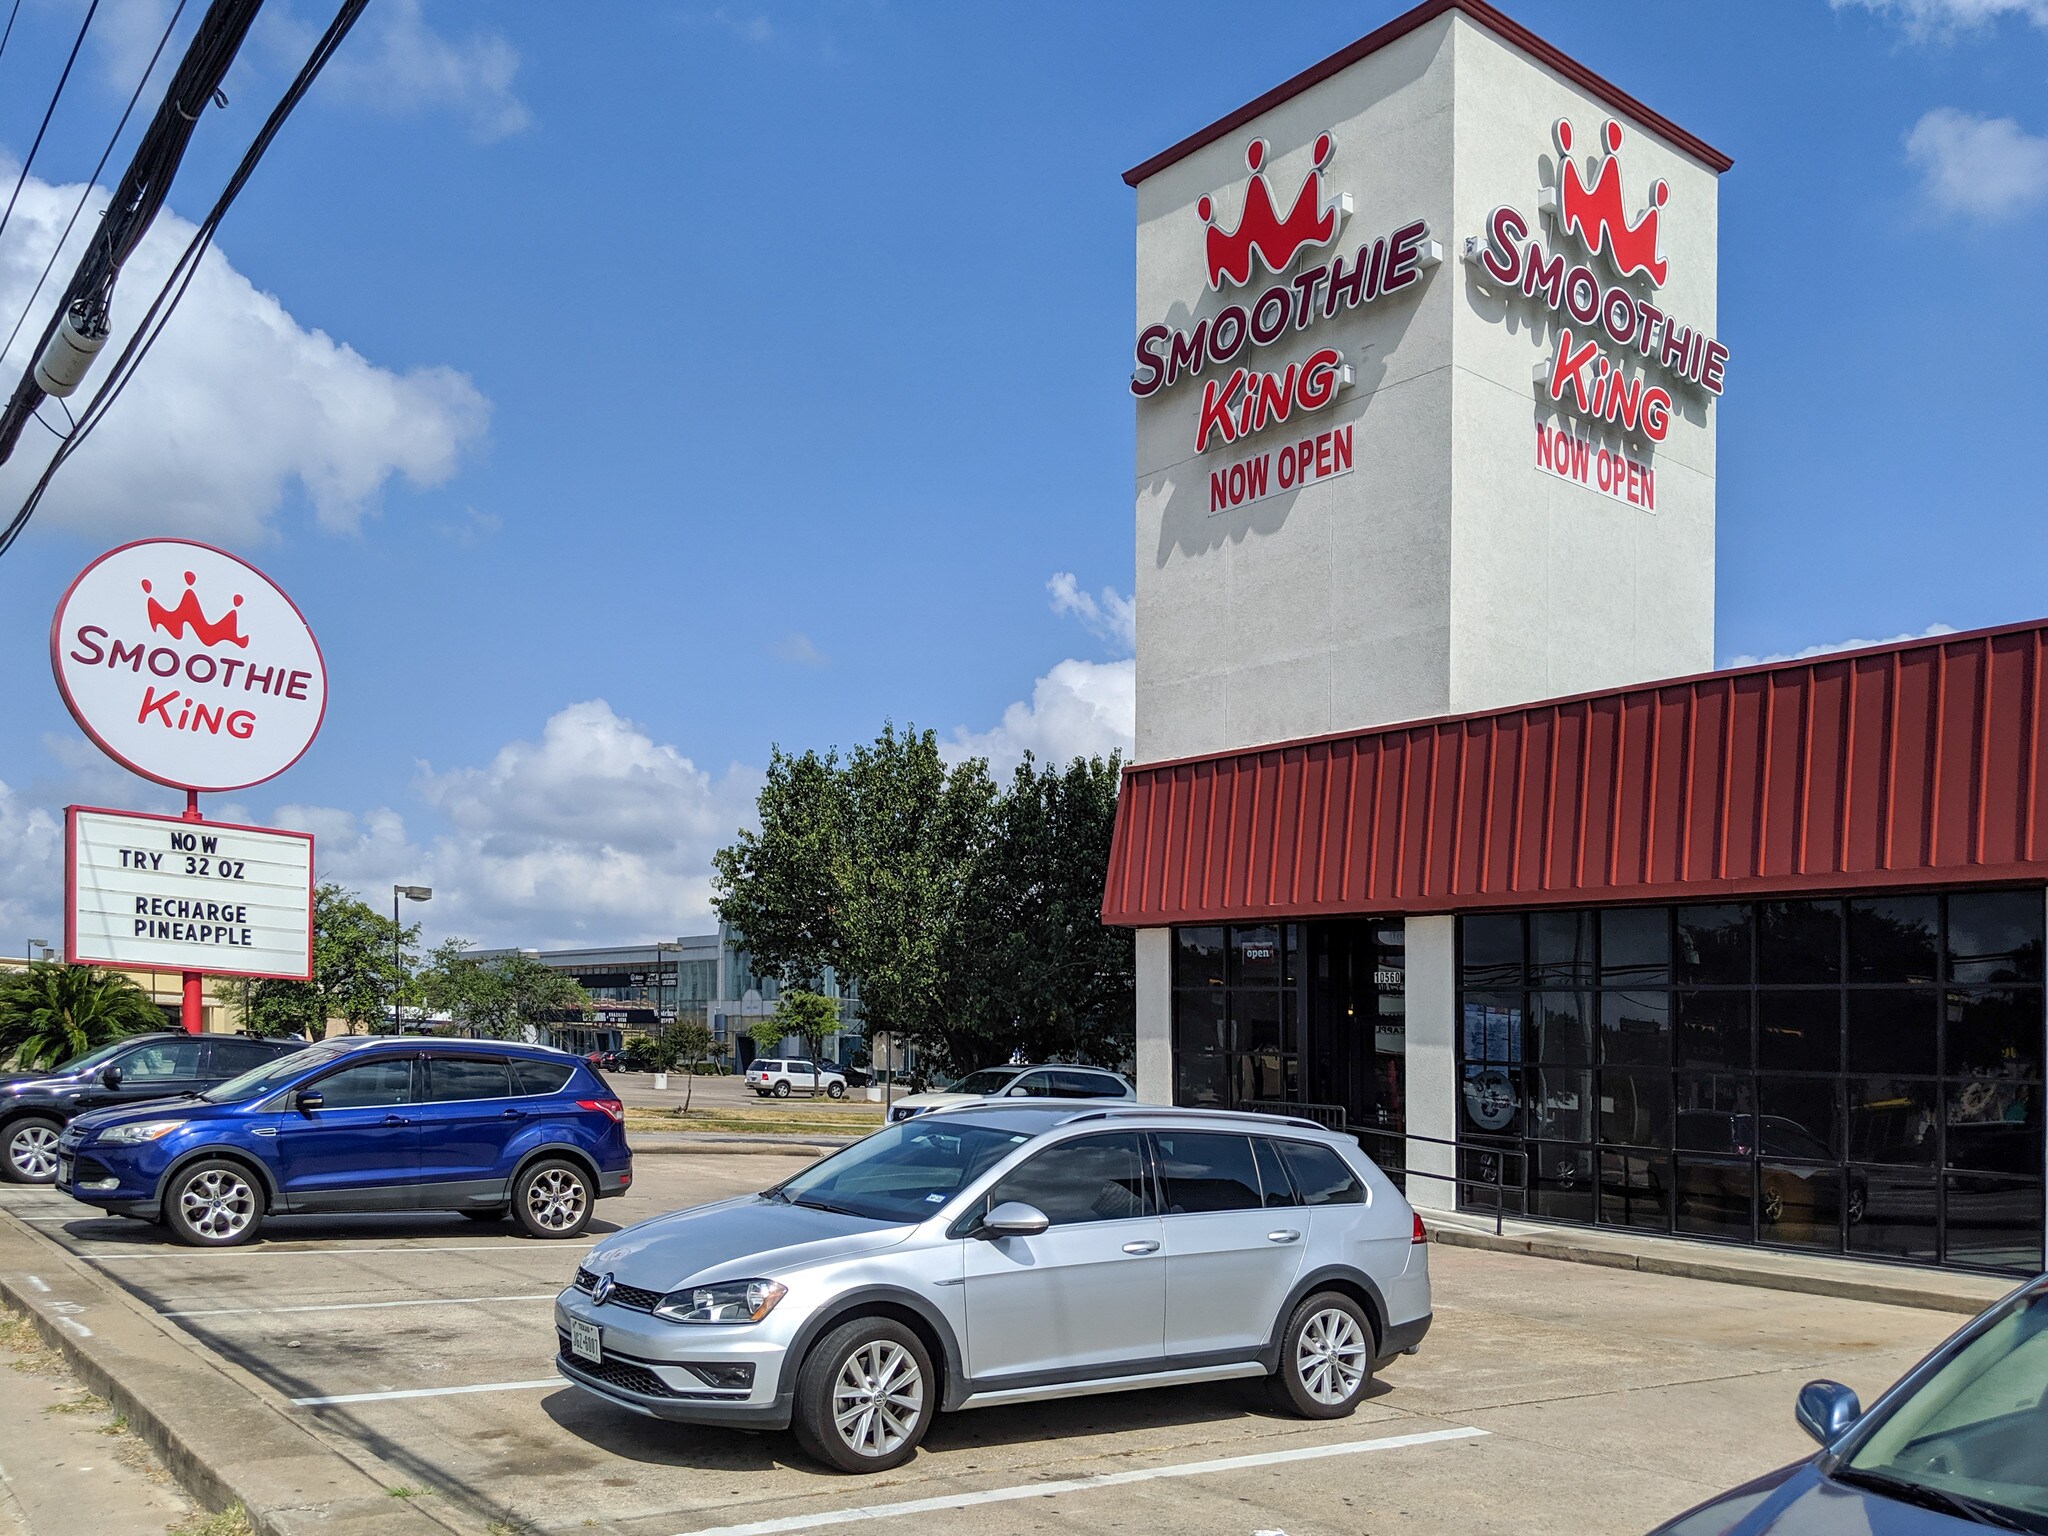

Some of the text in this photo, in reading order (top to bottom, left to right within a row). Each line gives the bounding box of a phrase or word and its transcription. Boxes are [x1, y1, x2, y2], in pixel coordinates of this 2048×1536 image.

[1128, 217, 1431, 399] SMOOTHIE
[1481, 204, 1731, 396] SMOOTHIE
[1210, 424, 1354, 513] NOW OPEN
[1536, 421, 1655, 512] NOW OPEN
[70, 624, 313, 701] SMOOTHIE
[170, 832, 218, 855] NOW
[118, 848, 245, 880] TRY 32 OZ
[135, 896, 247, 924] RECHARGE
[134, 918, 252, 946] PINEAPPLE
[1246, 949, 1270, 960] open
[1375, 972, 1400, 983] 10560
